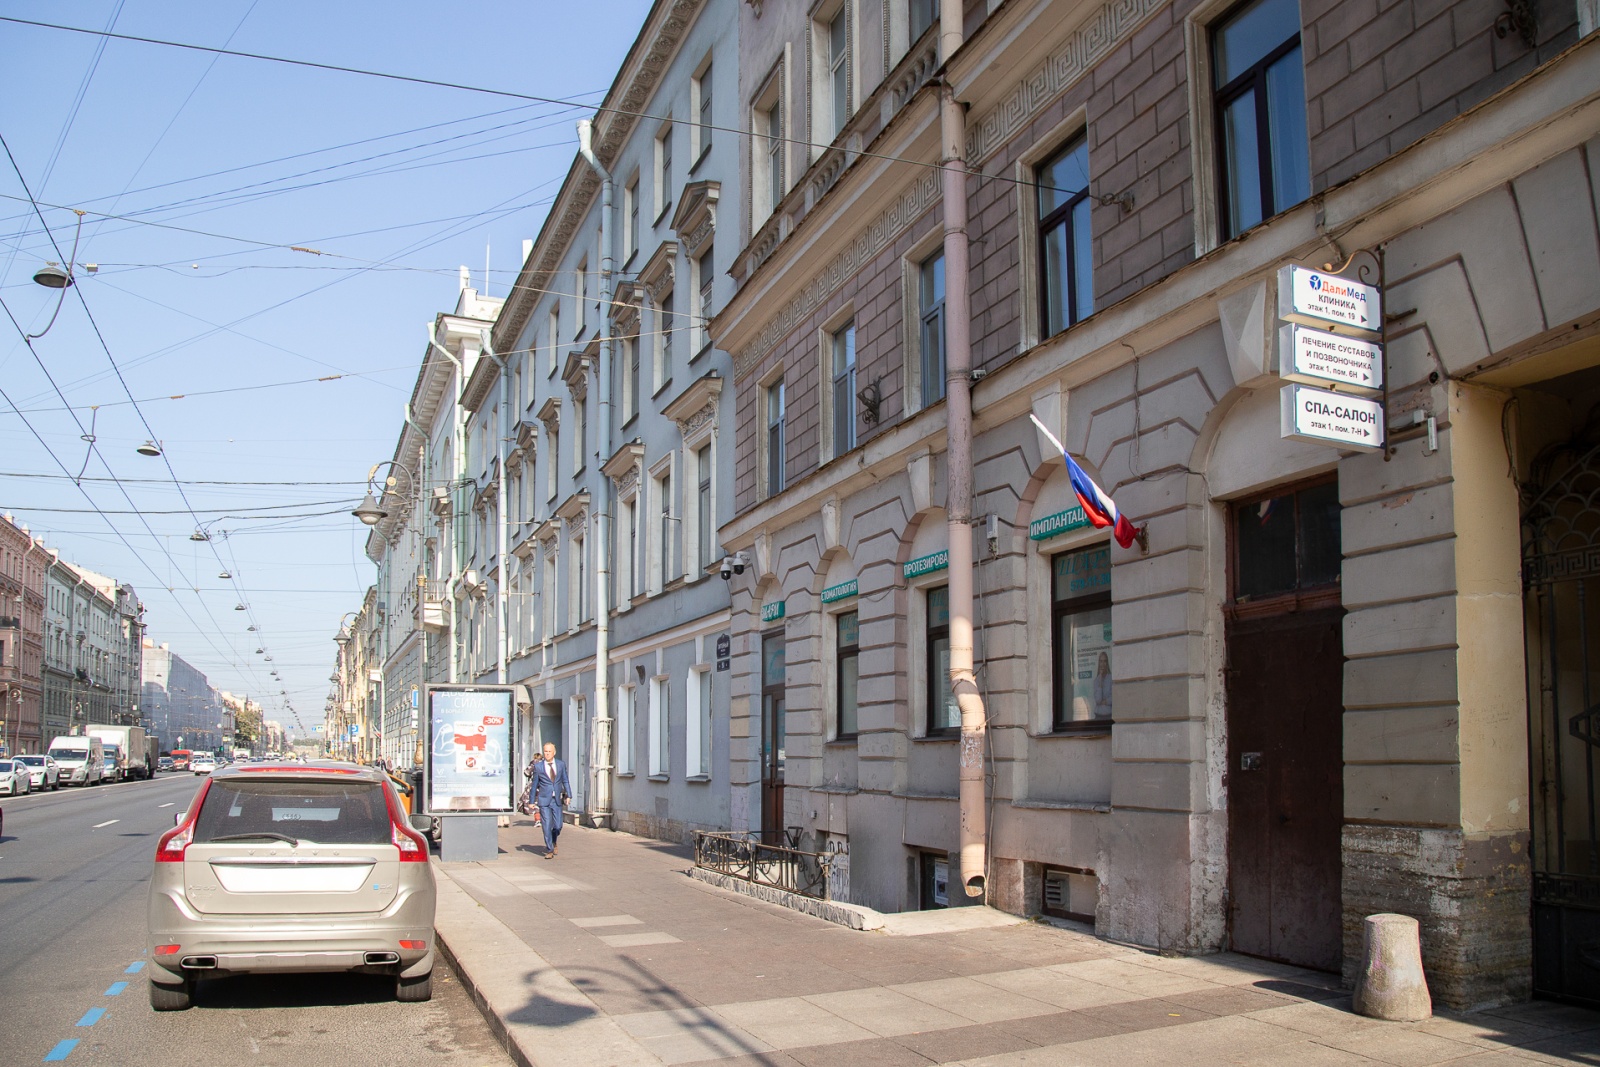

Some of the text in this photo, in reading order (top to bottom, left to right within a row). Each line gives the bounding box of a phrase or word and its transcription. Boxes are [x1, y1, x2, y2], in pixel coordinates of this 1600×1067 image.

[1318, 294, 1356, 310] КЛИНИКА
[1321, 280, 1367, 303] ДалиМед
[1307, 303, 1323, 313] этаж
[1331, 309, 1346, 319] пом.
[1348, 310, 1356, 320] 19
[1302, 336, 1376, 359] ЛЕЧЕНИЕ СУСТАВОВ
[1306, 349, 1373, 371] И ПОЗВОНОЧНИКА
[1308, 362, 1324, 372] этаж
[1332, 367, 1347, 377] пом.
[1348, 369, 1358, 379] 6Н
[1305, 400, 1376, 425] СПА-САЛОН
[1310, 420, 1327, 430] этаж
[1334, 424, 1350, 434] пом.
[1351, 427, 1362, 436] 7-Н
[1030, 507, 1088, 537] ИМПЛАНТАЦ
[820, 581, 857, 602] СТОМАТОЛОГИЯ
[453, 697, 486, 708] СИЛА
